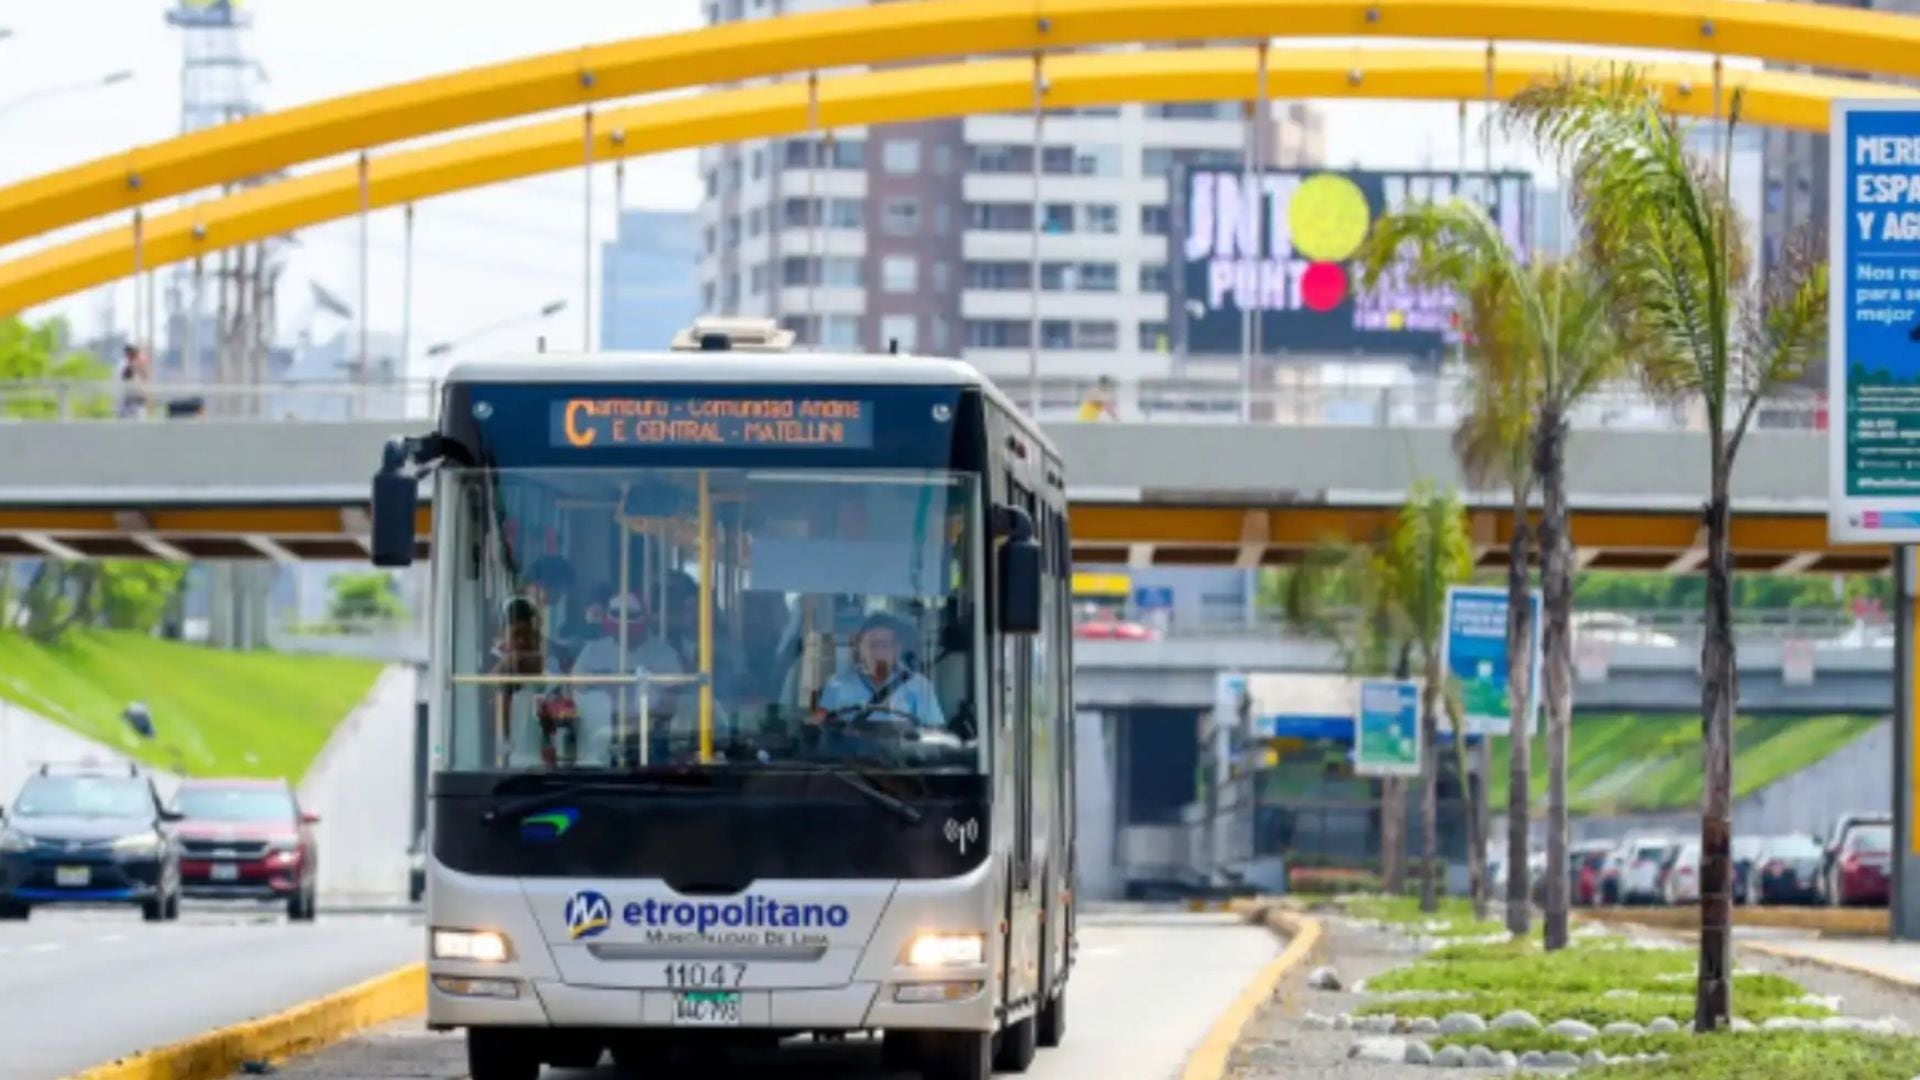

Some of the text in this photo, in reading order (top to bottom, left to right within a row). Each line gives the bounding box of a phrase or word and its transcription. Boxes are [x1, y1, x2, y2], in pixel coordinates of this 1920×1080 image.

[1856, 212, 1875, 241] Y
[1857, 264, 1894, 281] Nos
[1857, 289, 1901, 305] para
[1857, 307, 1914, 327] mejor
[564, 398, 597, 448] C
[613, 420, 626, 442] E
[636, 420, 724, 442] CENTRAL
[745, 421, 844, 442] MATELLINI
[664, 963, 746, 987] 11047
